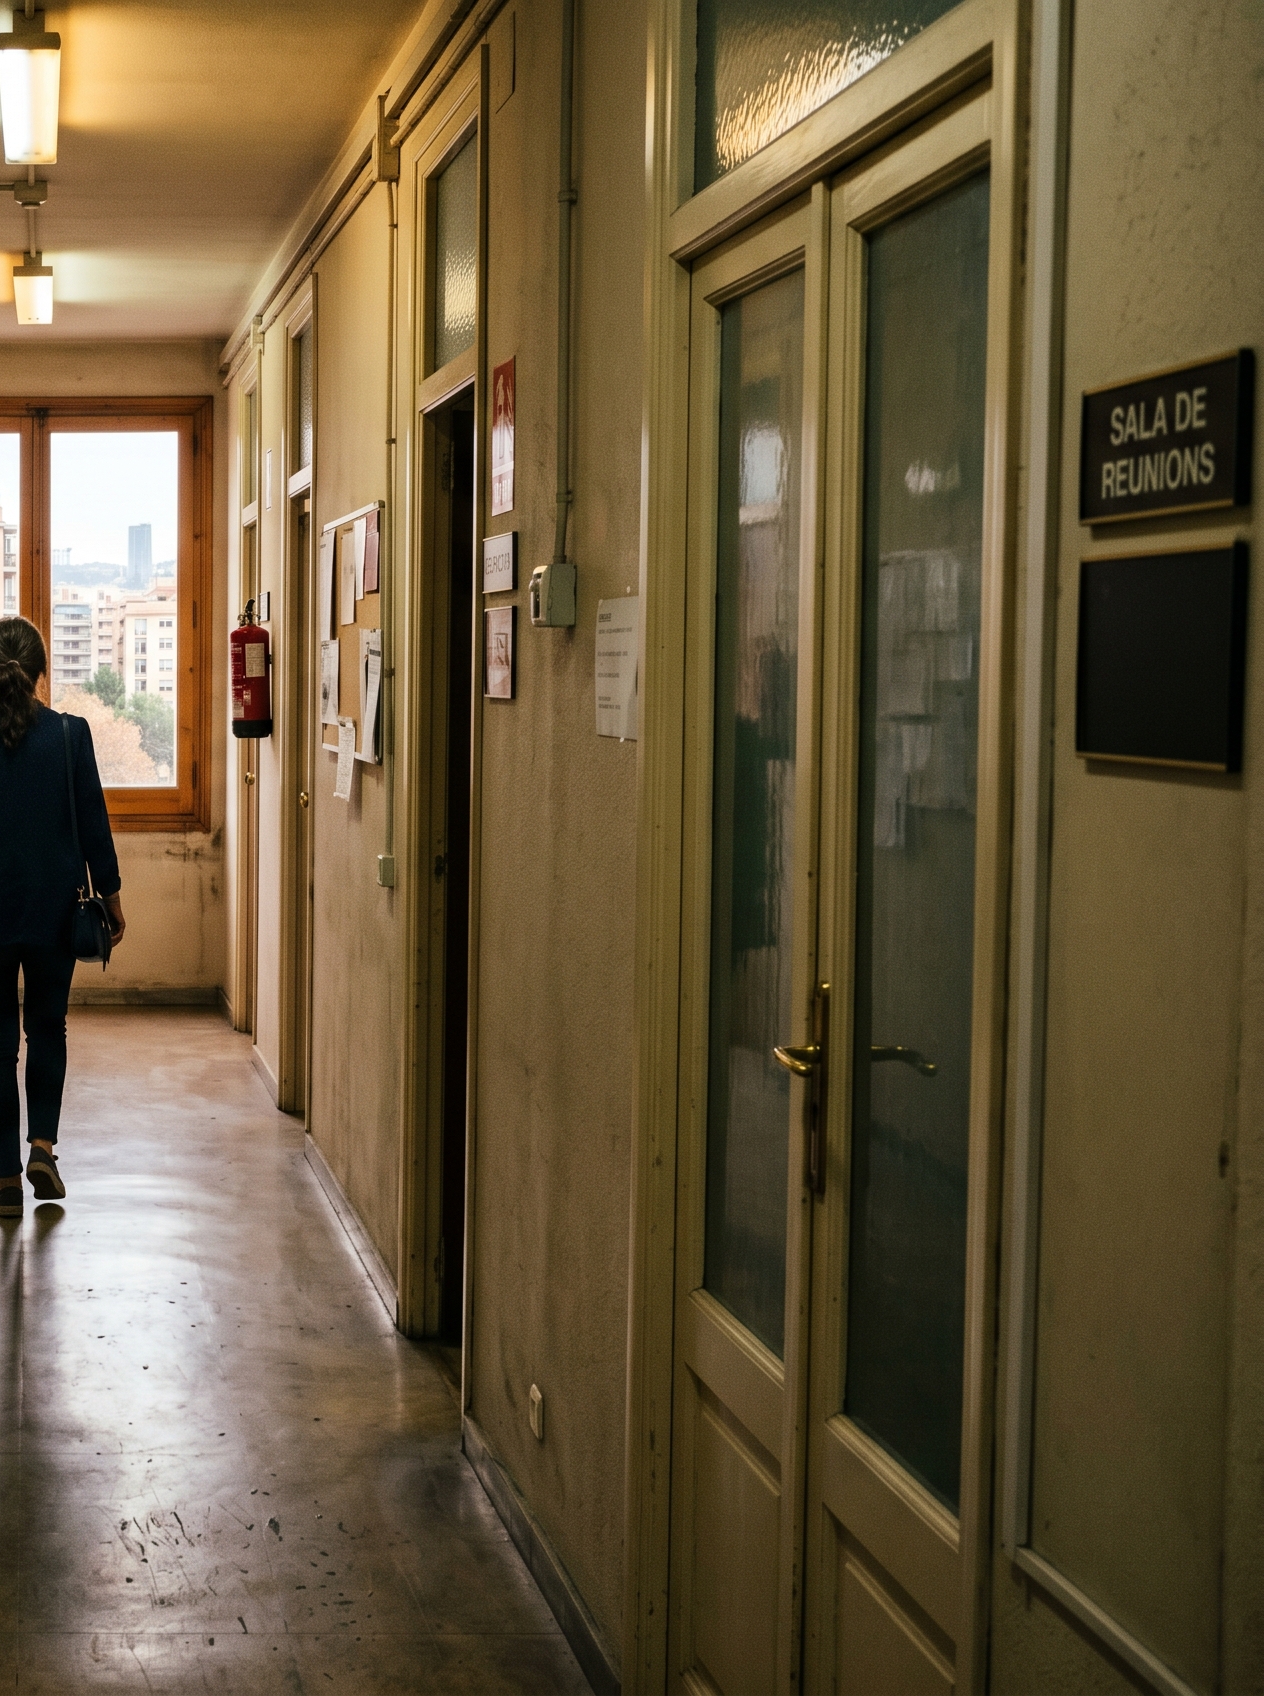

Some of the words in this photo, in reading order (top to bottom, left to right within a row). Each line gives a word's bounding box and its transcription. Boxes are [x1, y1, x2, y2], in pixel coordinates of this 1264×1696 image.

[1109, 396, 1168, 446] SALA
[1174, 386, 1207, 432] DE
[1101, 442, 1215, 499] REUNIONS
